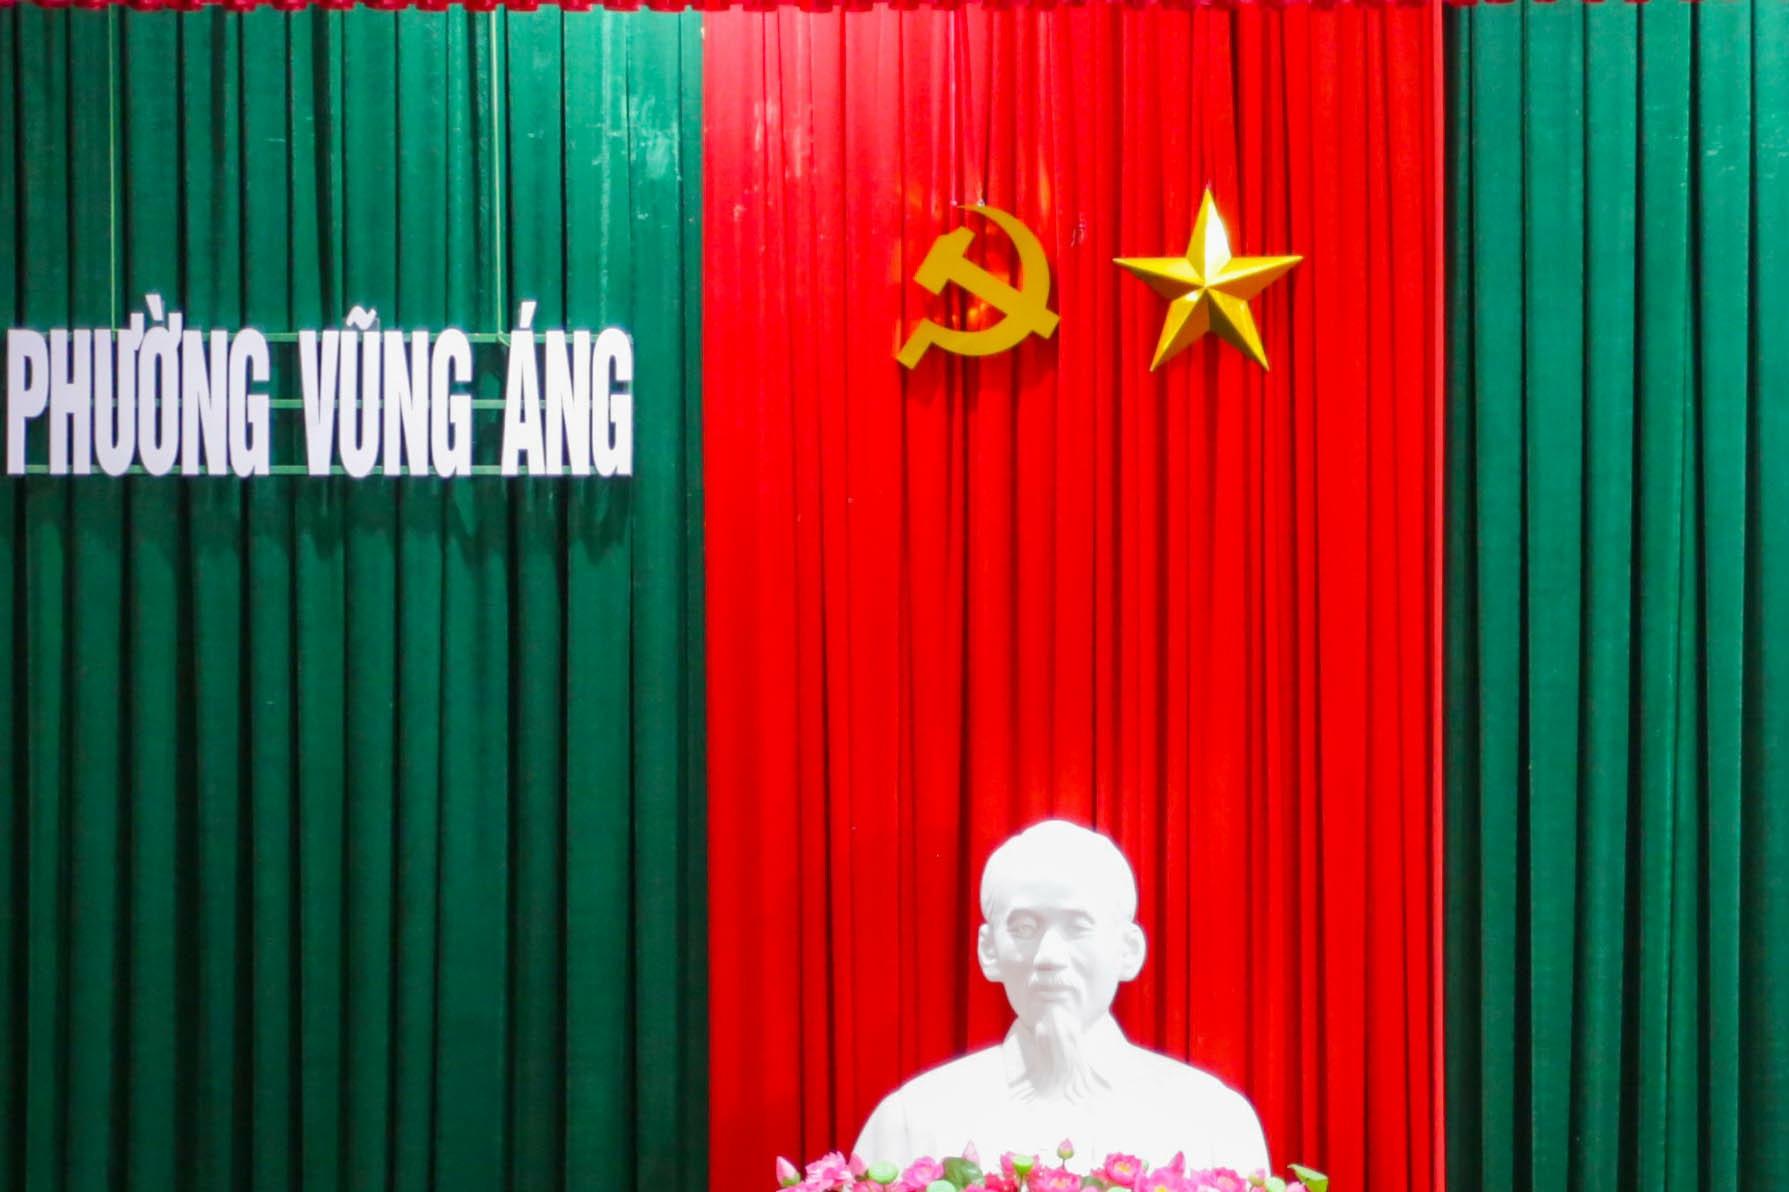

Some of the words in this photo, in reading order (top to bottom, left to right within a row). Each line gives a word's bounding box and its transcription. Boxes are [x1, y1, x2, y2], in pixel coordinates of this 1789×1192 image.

[7, 294, 271, 478] PHƯỜNG
[299, 306, 472, 478] VŨNG
[501, 301, 634, 478] ÁNG
